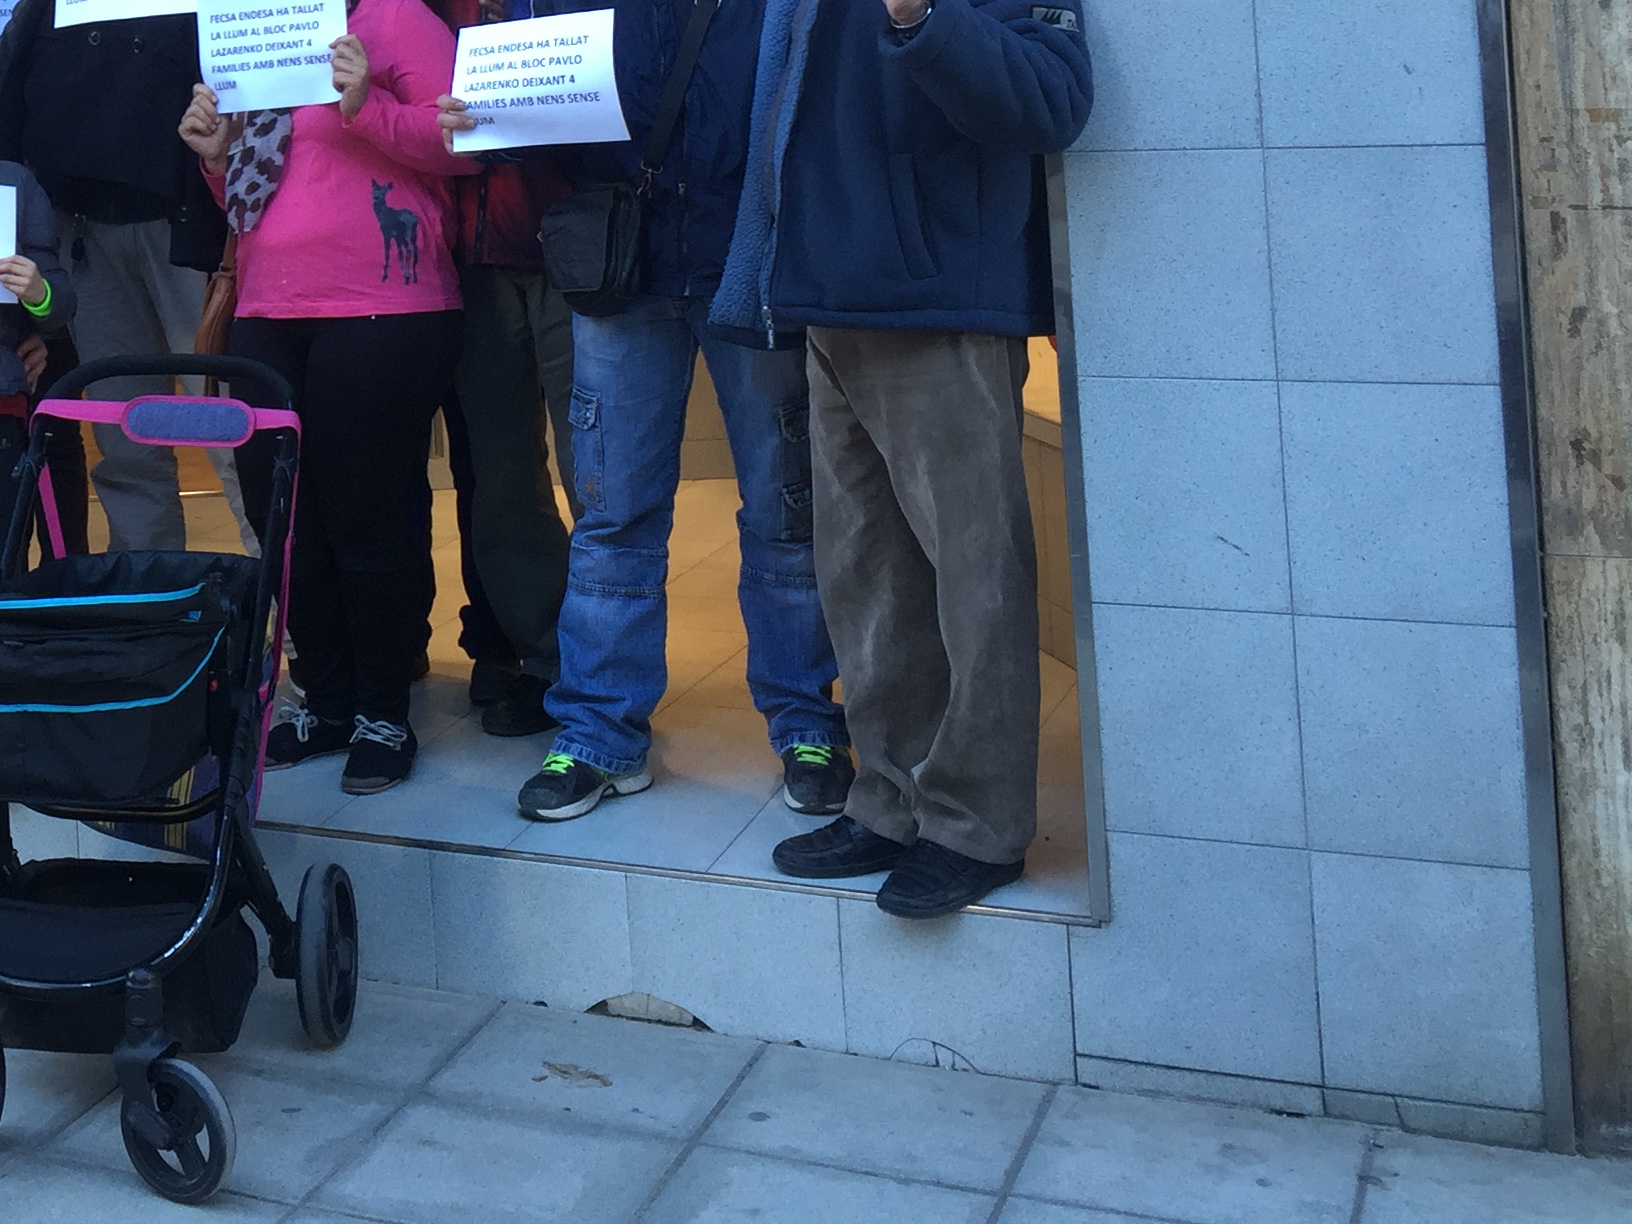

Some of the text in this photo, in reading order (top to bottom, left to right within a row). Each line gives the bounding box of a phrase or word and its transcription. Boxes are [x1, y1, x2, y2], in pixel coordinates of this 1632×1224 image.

[210, 3, 324, 23] FECSA ENDESA HA TALLAT
[211, 21, 319, 41] LA LLUM AL BLOC PAVLO
[211, 44, 263, 57] LAZARENKO
[265, 39, 304, 52] DEIXANT
[469, 35, 588, 57] FECSA ENDESA HA TALLAT
[212, 53, 332, 74] FAMILIES AMB NENS SENSE
[467, 55, 582, 75] LA LLUM AL BLOC PAVLO
[214, 81, 236, 91] LLUM
[464, 78, 518, 92] LAZARENKO
[522, 75, 566, 87] DEIXANT
[509, 96, 534, 107] AMB
[537, 94, 565, 105] NENS
[568, 92, 600, 103] SENSE
